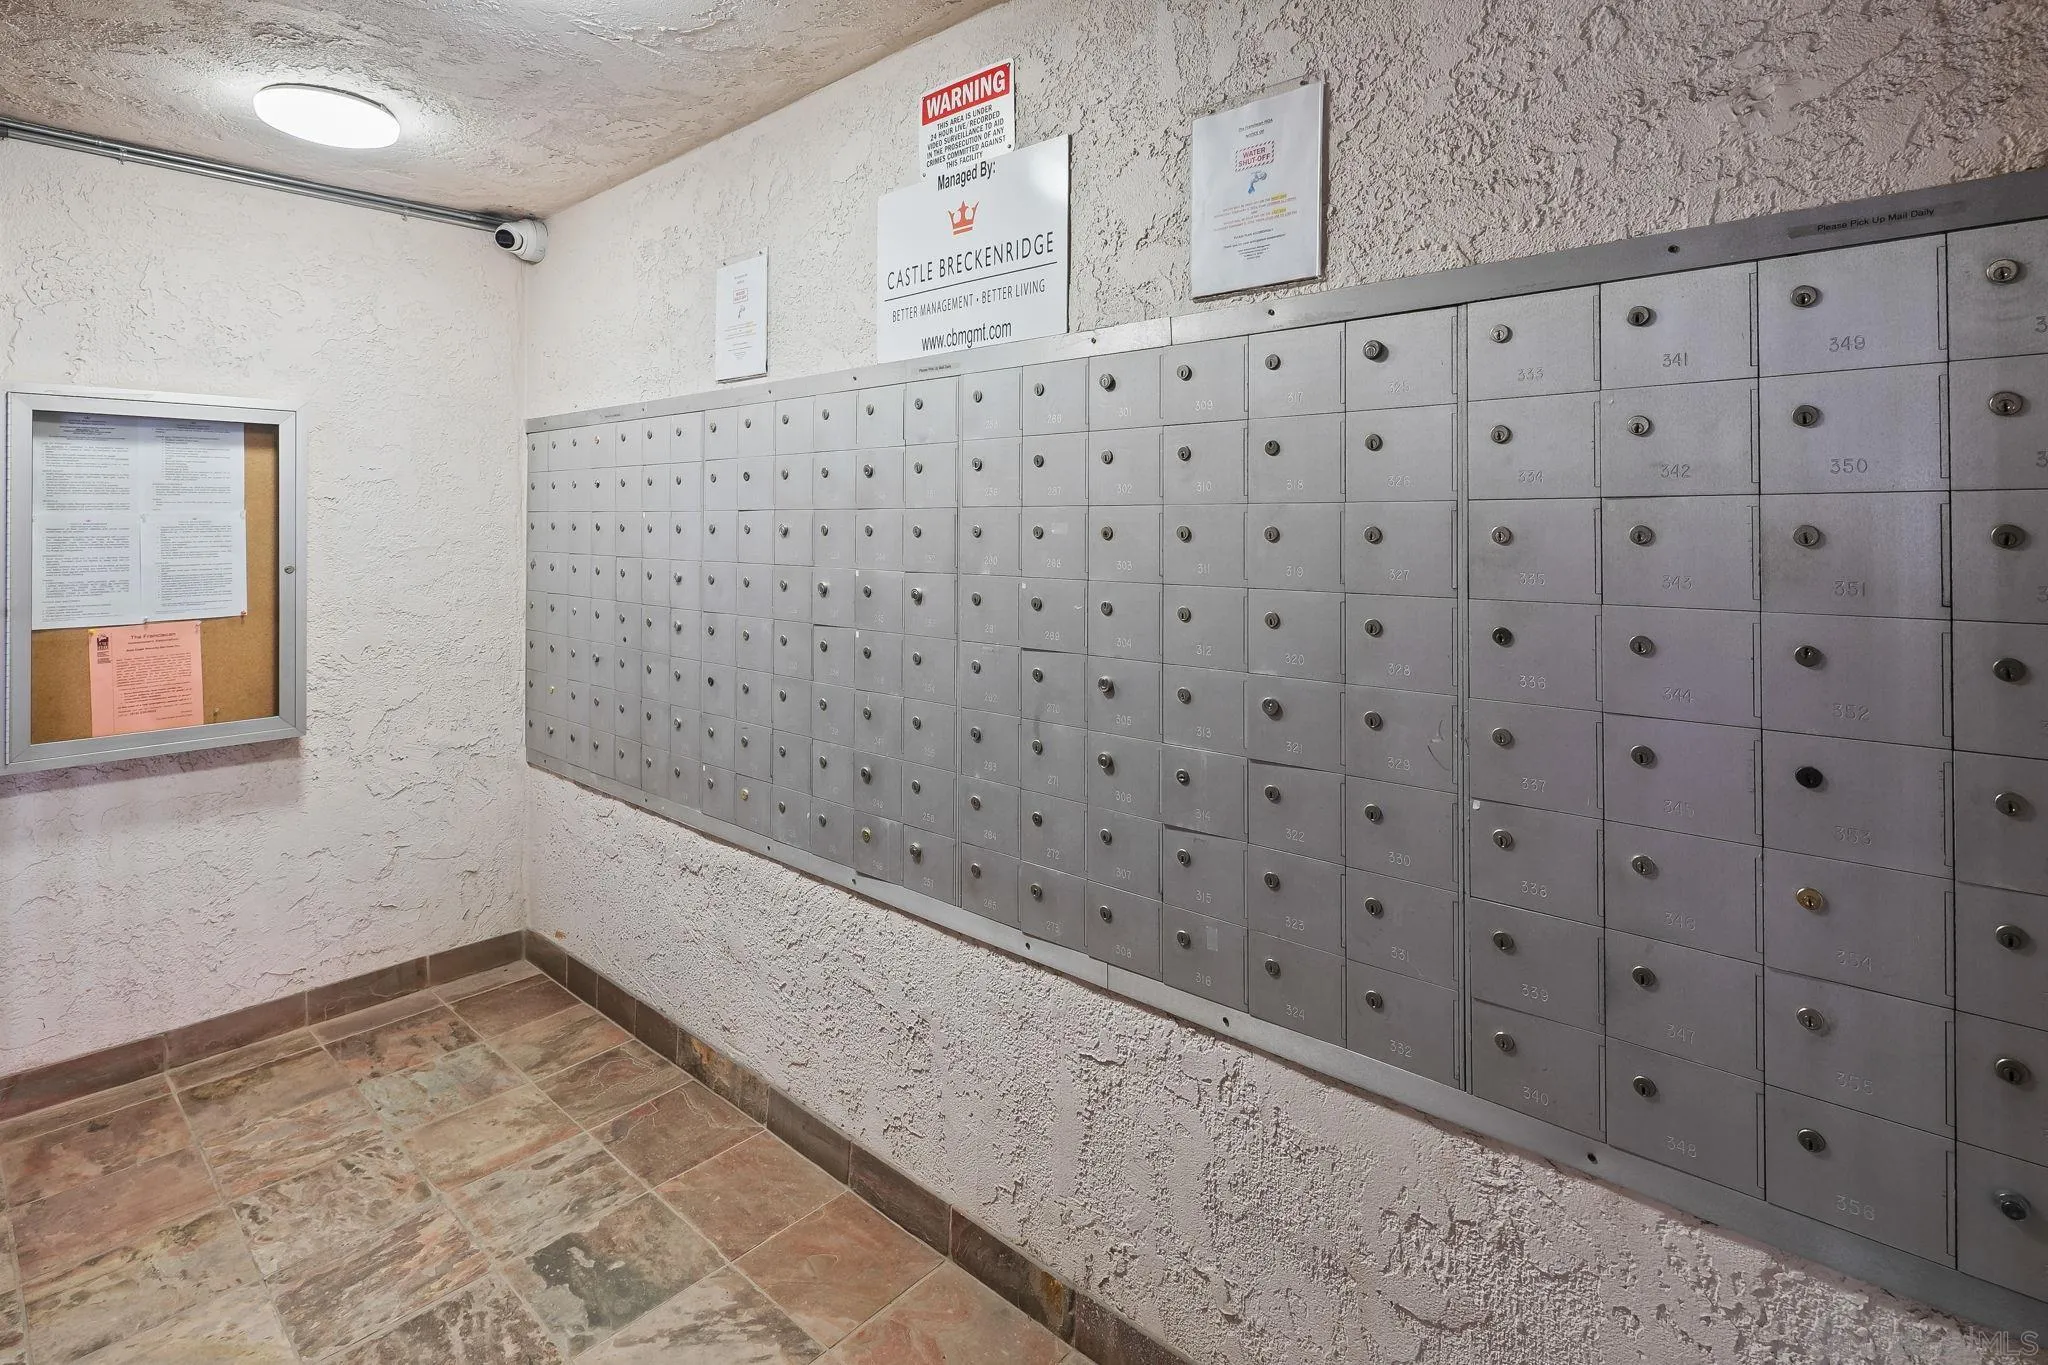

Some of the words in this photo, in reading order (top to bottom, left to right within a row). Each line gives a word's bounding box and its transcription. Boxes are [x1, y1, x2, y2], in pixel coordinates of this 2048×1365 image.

[926, 70, 1006, 119] WARNING
[937, 121, 949, 130] THIS
[950, 115, 964, 126] AREA
[972, 104, 992, 117] UNDER
[930, 133, 937, 141] 24
[939, 127, 953, 138] HOUR
[954, 110, 1001, 133] LIVE/RECORDED
[927, 139, 943, 151] VIDEO
[944, 124, 984, 145] SURVEILLANCE
[985, 122, 992, 131] TO
[993, 118, 1004, 128] AID
[927, 151, 933, 159] IN
[934, 147, 943, 157] THE
[945, 134, 982, 153] PROSECUTION
[984, 132, 991, 140] OF
[993, 126, 1005, 136] ANY
[927, 154, 946, 168] CRIMES
[947, 143, 979, 160] COMMITTED
[981, 135, 1006, 149] AGAINST
[1243, 147, 1266, 158] WATER
[946, 160, 958, 169] THIS
[960, 151, 983, 164] FACILITY
[1239, 153, 1271, 167] SHUT-OFF
[937, 163, 978, 191] Managed
[980, 161, 996, 180] By:
[1817, 222, 1848, 232] Please
[1850, 217, 1869, 227] Pick
[1872, 215, 1886, 225] Up
[1888, 211, 1908, 221] Mail
[1911, 207, 1935, 218] Daily
[887, 261, 933, 290] CASTLE
[939, 231, 1054, 278] BRECKENRIDGE
[892, 306, 918, 323] BETTER
[919, 293, 974, 317] MANAGEMENT
[982, 286, 1013, 304] BETTER
[1015, 278, 1046, 298] LIVING
[921, 322, 1012, 351] www.cbmgmt.com
[1829, 335, 1866, 352] 349
[1663, 352, 1688, 367] 341
[1518, 367, 1544, 382] 333
[1118, 407, 1132, 417] 301
[1194, 400, 1213, 411] 309
[1661, 464, 1690, 478] 342
[1830, 458, 1868, 475] 350
[1518, 471, 1544, 484] 334
[1117, 484, 1133, 494] 302
[1196, 480, 1212, 492] 310
[1197, 564, 1210, 574] 311
[1286, 566, 1304, 577] 319
[1388, 569, 1410, 581] 327
[1519, 572, 1545, 585] 335
[1663, 575, 1694, 591] 343
[1833, 581, 1866, 598] 351
[1116, 638, 1132, 648] 304
[1196, 644, 1212, 656] 312
[1284, 654, 1304, 665] 320
[1519, 674, 1546, 690] 336
[1663, 687, 1694, 703] 344
[1832, 704, 1870, 720] 352
[1196, 726, 1212, 738] 313
[1286, 742, 1303, 754] 321
[1520, 778, 1546, 792] 337
[1664, 800, 1695, 818] 345
[1286, 828, 1305, 842] 322
[1833, 825, 1873, 846] 353
[1388, 852, 1411, 867] 330
[1116, 867, 1132, 880] 307
[1196, 890, 1212, 904] 315
[1196, 972, 1212, 987] 316
[1286, 1005, 1305, 1020] 324
[1666, 1024, 1696, 1044] 347
[1390, 1040, 1412, 1057] 332
[1522, 1087, 1549, 1105] 340
[1667, 1137, 1697, 1158] 348
